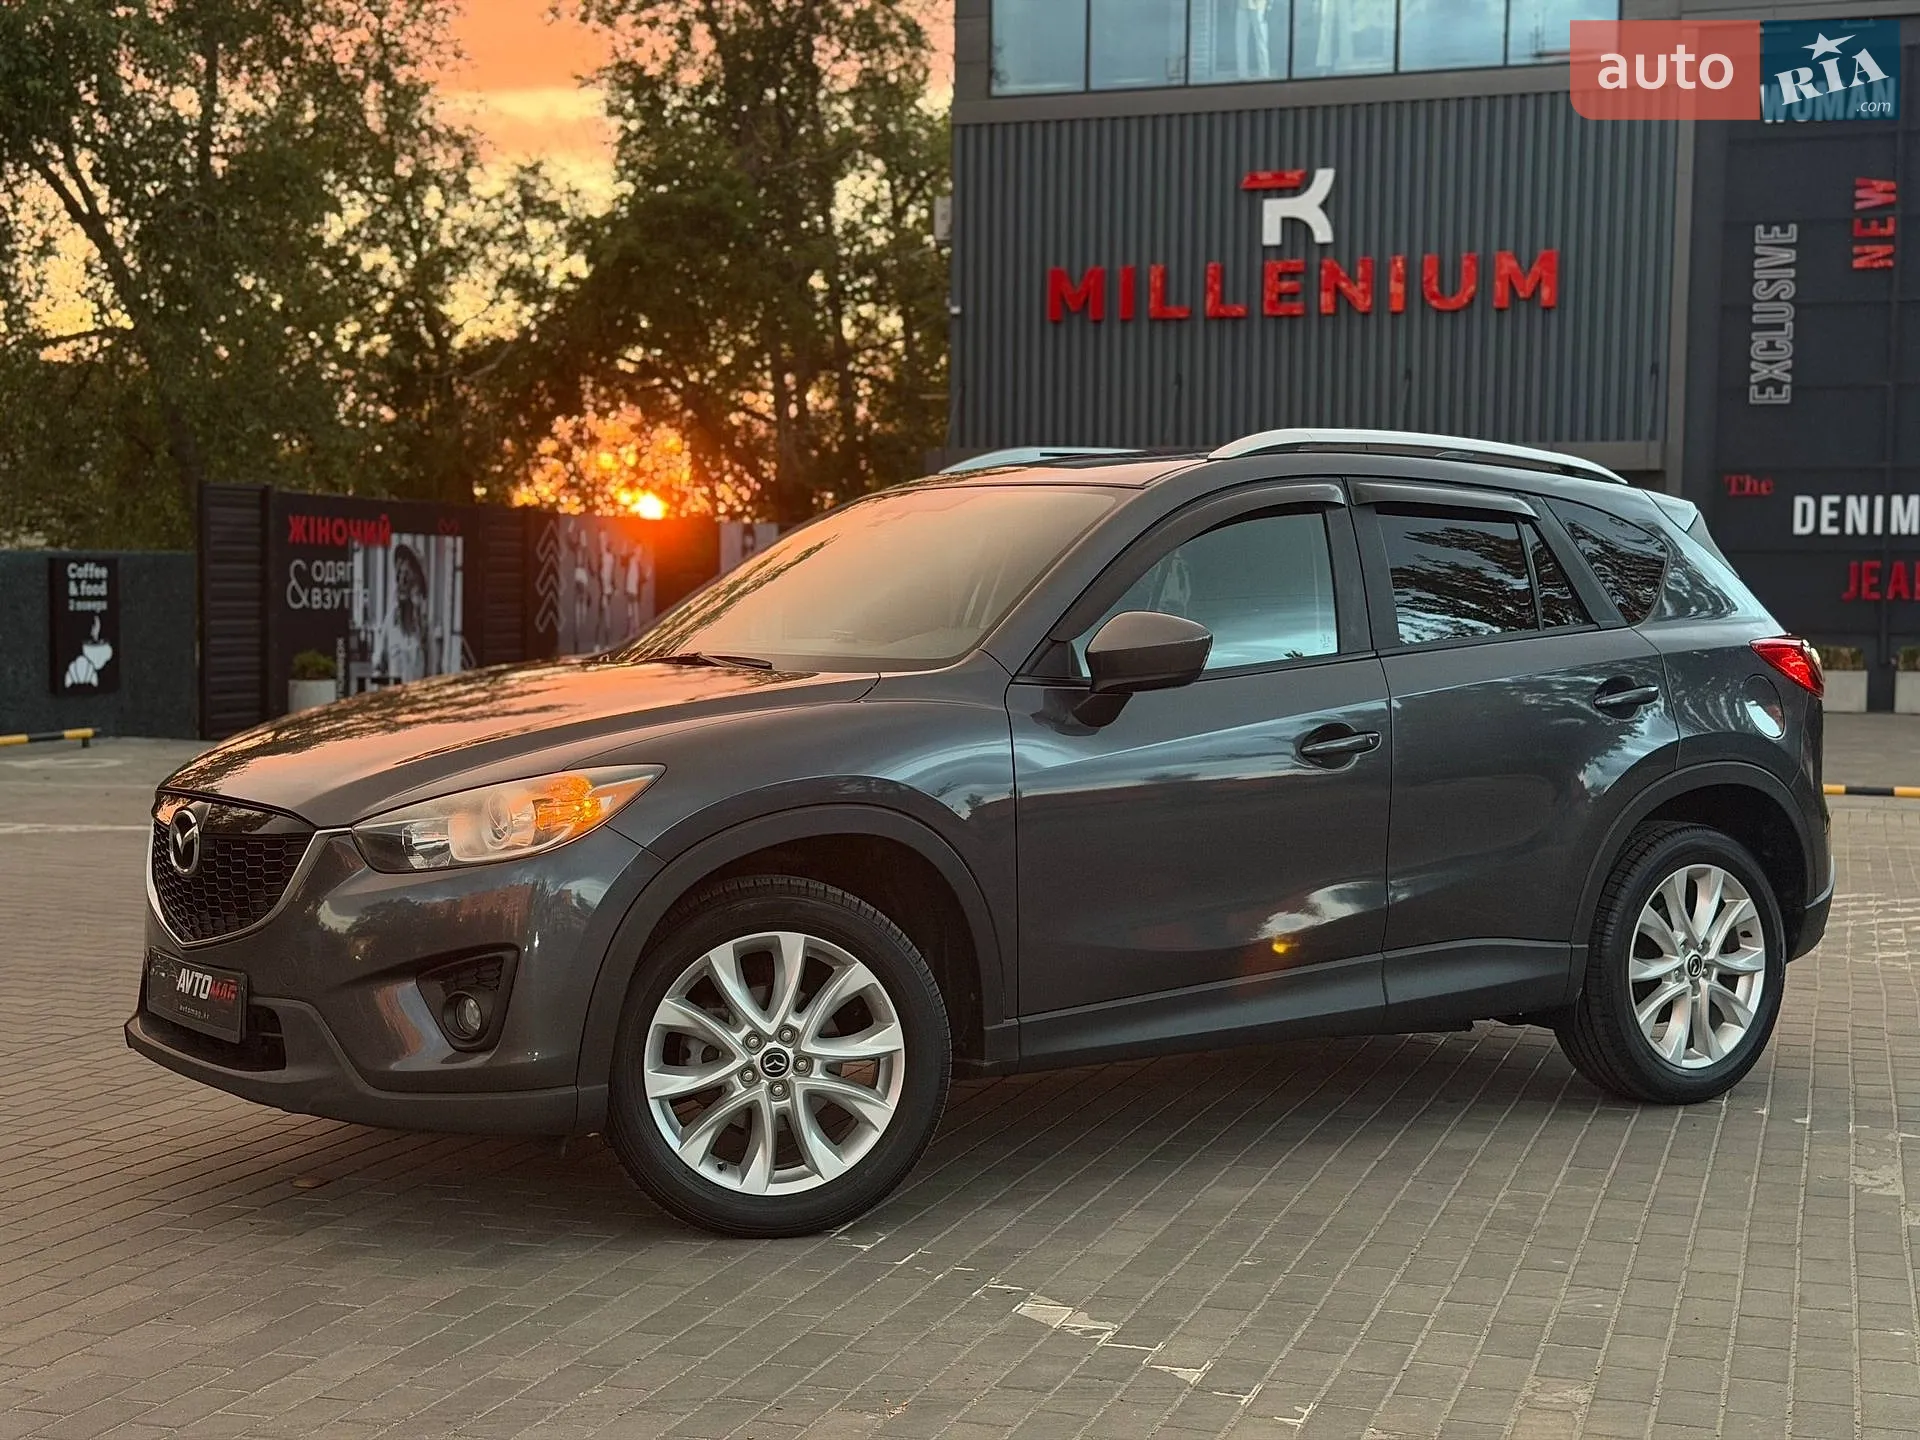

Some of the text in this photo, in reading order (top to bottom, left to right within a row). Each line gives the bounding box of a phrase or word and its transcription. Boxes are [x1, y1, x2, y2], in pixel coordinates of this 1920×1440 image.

[1852, 178, 1897, 270] NEW
[1046, 249, 1559, 322] MILLENIUM
[1749, 223, 1798, 404] EXCLUSIVE
[1724, 474, 1774, 497] The
[288, 513, 392, 547] ЖІНОЧИЙ
[1793, 495, 1920, 536] DENIM
[67, 562, 108, 579] Coffee
[80, 580, 107, 597] food
